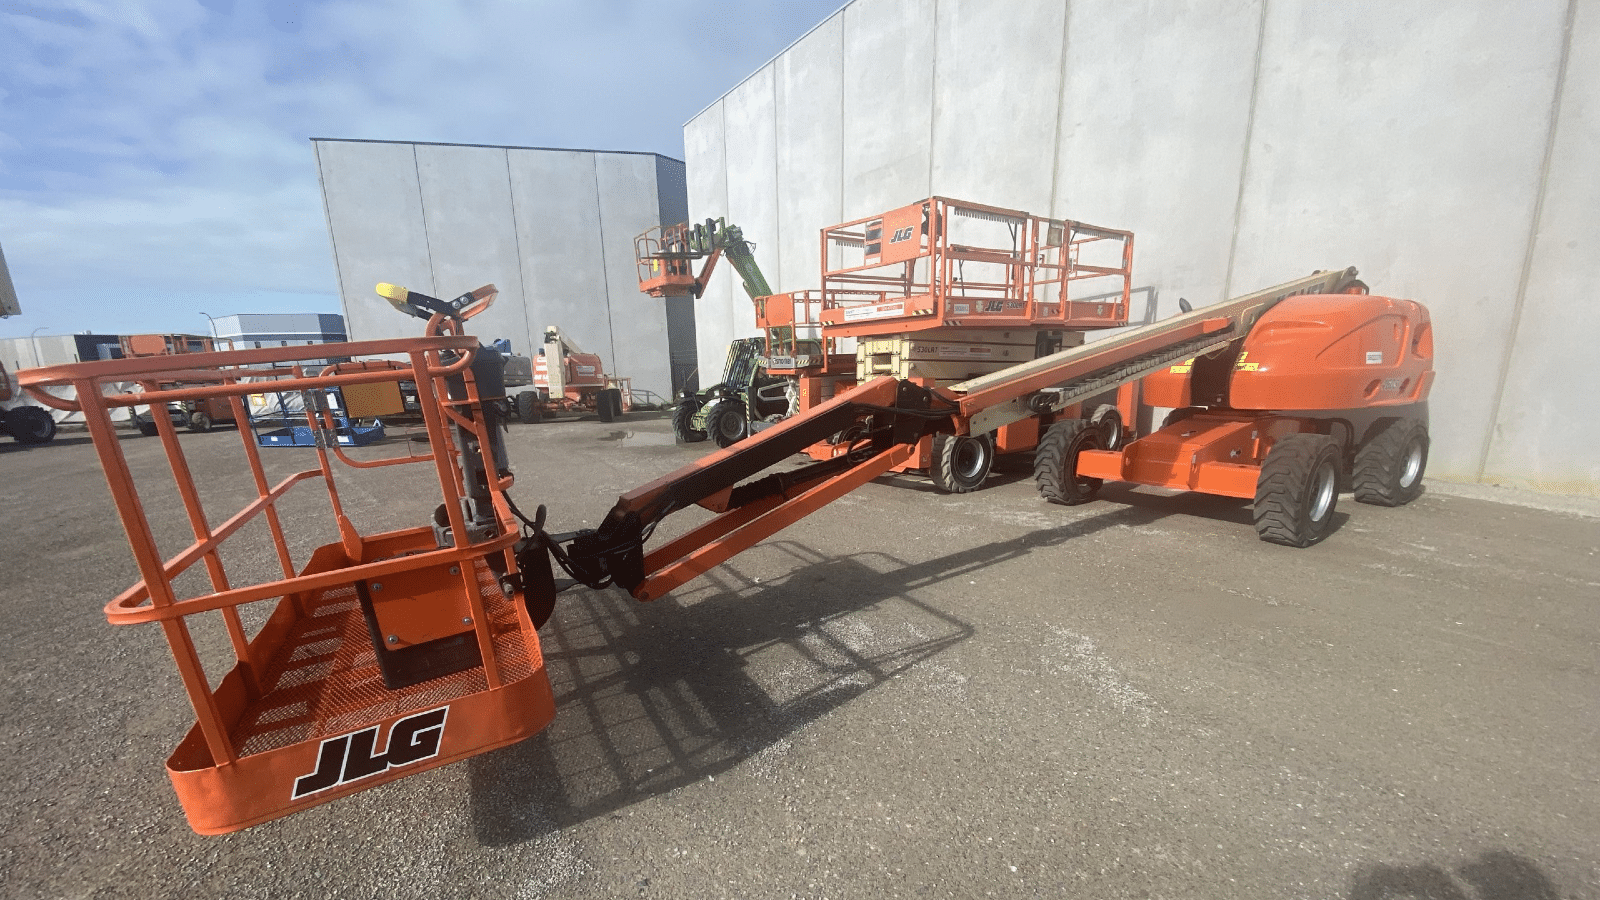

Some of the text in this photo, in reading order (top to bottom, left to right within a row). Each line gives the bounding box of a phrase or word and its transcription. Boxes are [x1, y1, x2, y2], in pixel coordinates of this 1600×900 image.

[889, 226, 914, 244] JLG
[984, 301, 1003, 312] JLG
[291, 705, 450, 800] JLG
